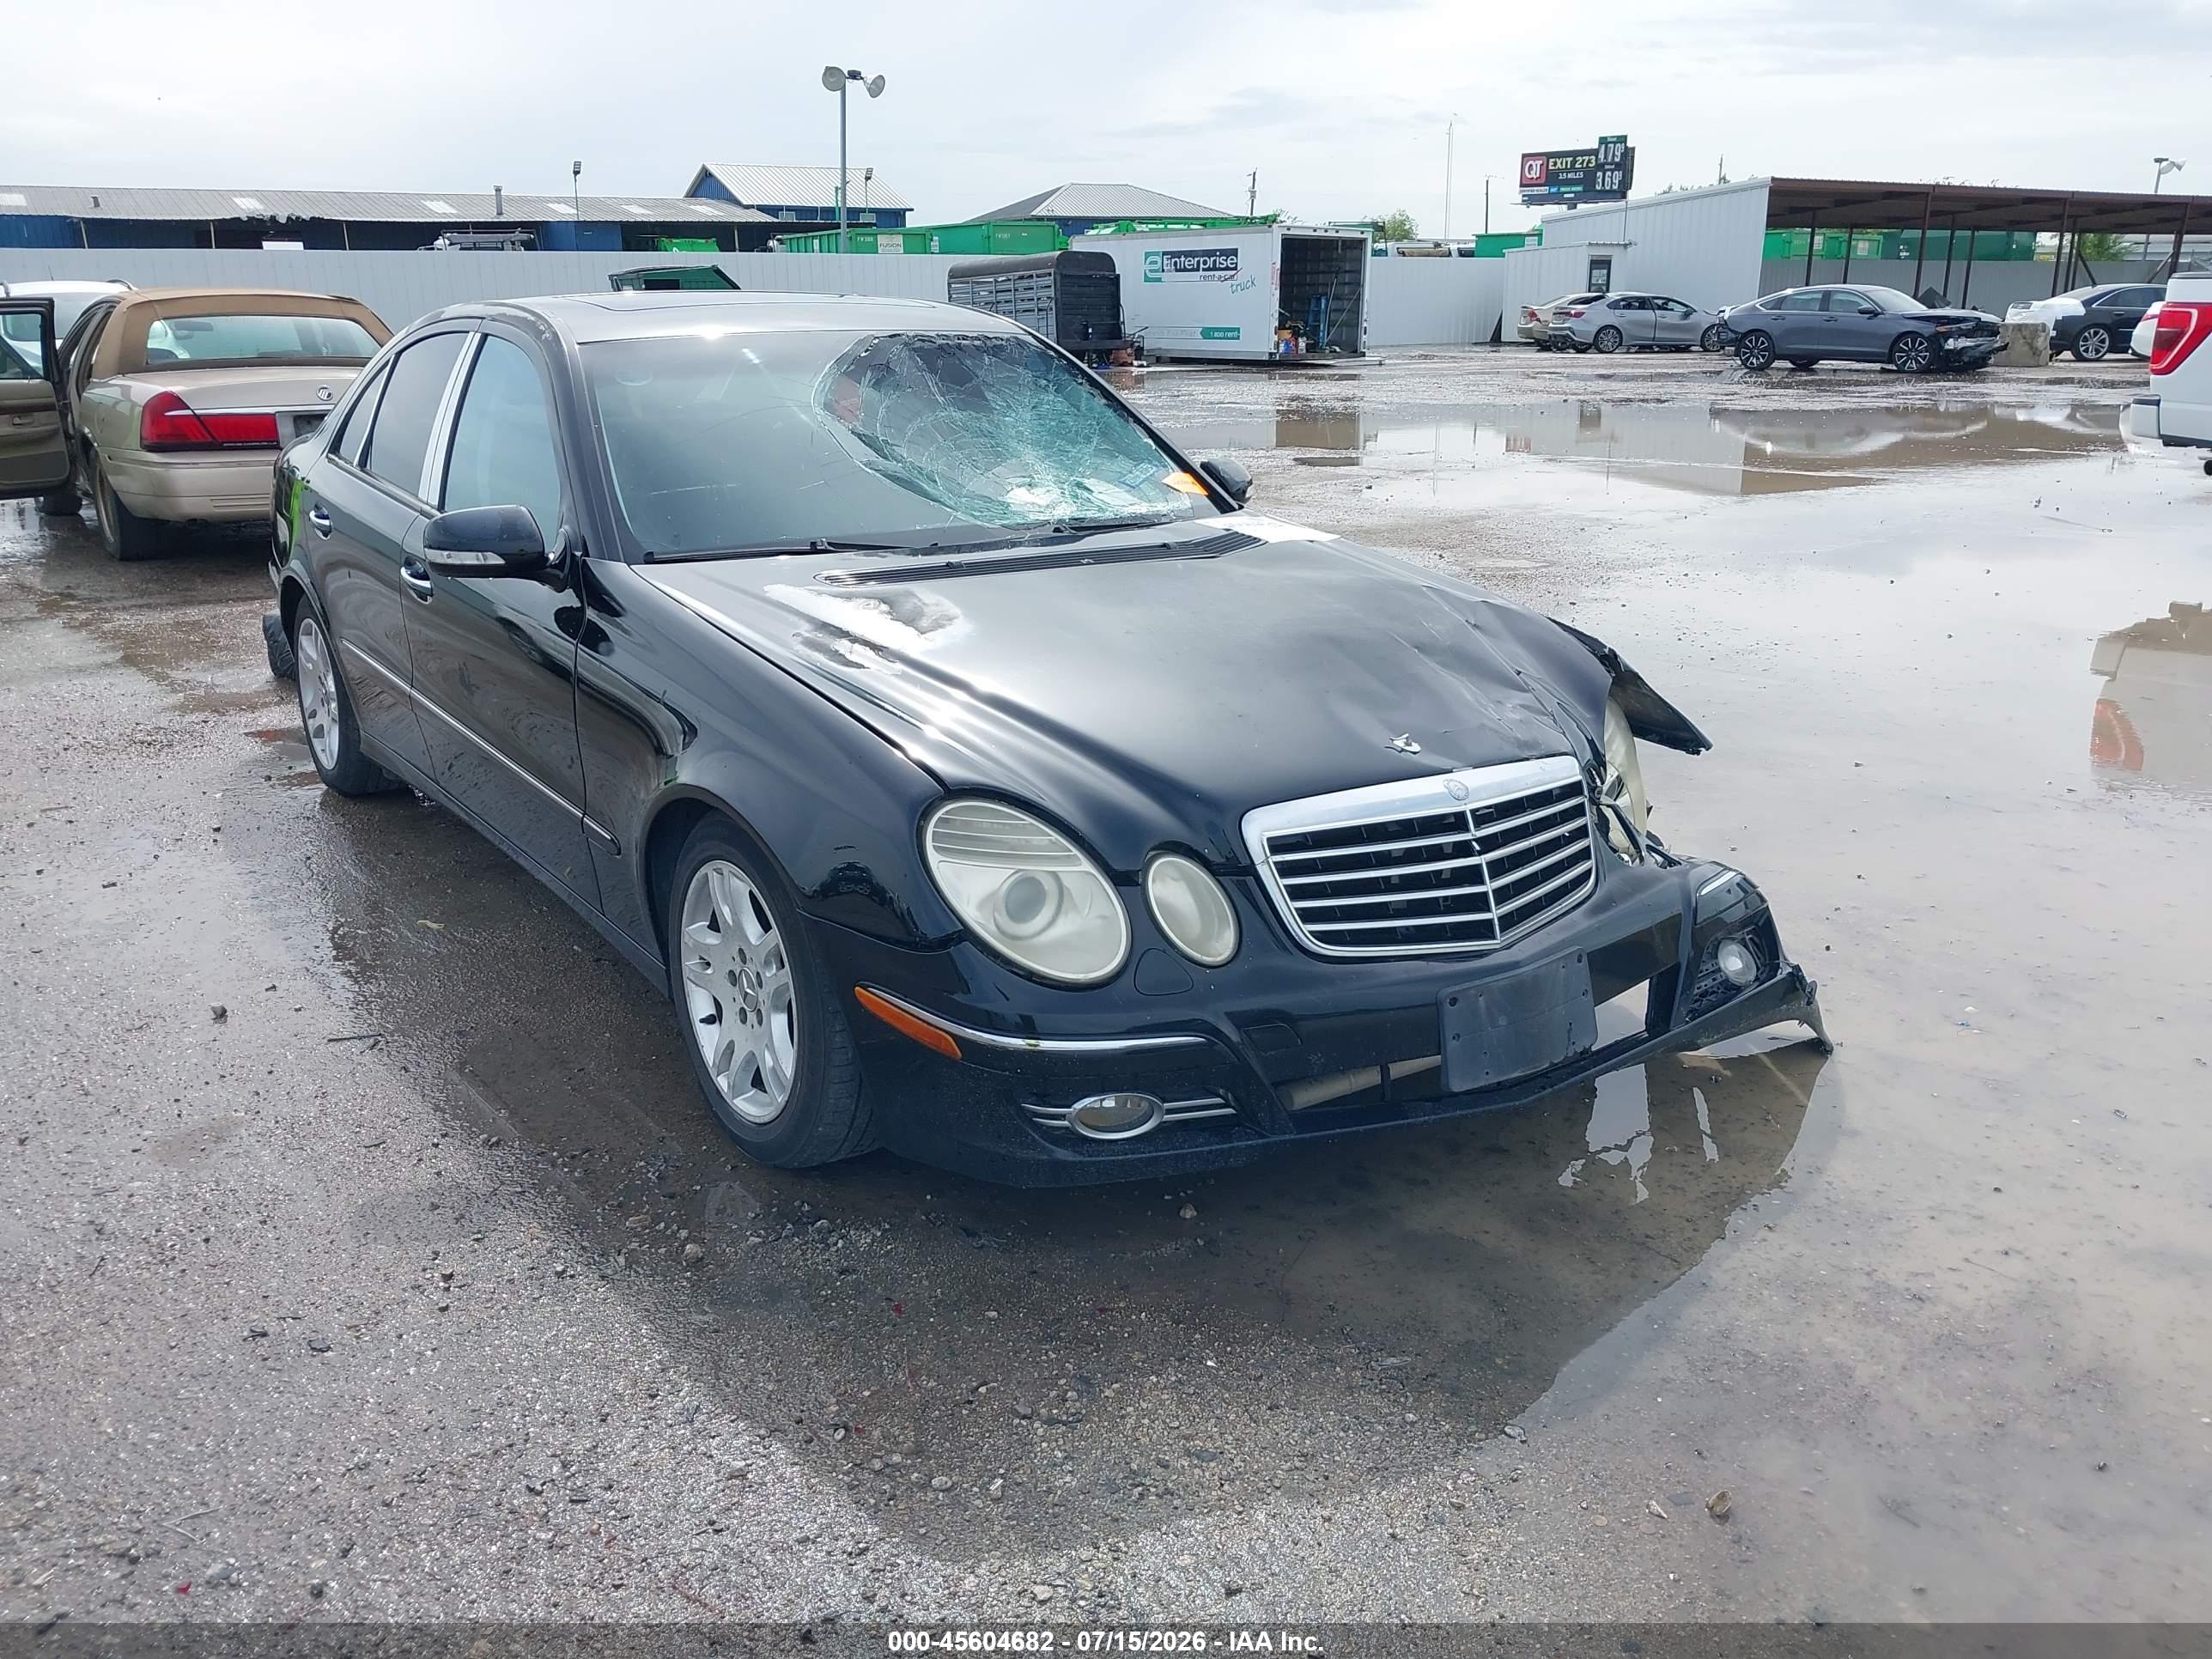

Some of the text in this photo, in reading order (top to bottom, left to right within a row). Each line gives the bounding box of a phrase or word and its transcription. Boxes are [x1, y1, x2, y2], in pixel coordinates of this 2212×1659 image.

[1525, 161, 1543, 179] QT
[1548, 155, 1595, 170] EXIT 273
[1163, 252, 1237, 273] Enterprise
[1230, 275, 1256, 295] truck
